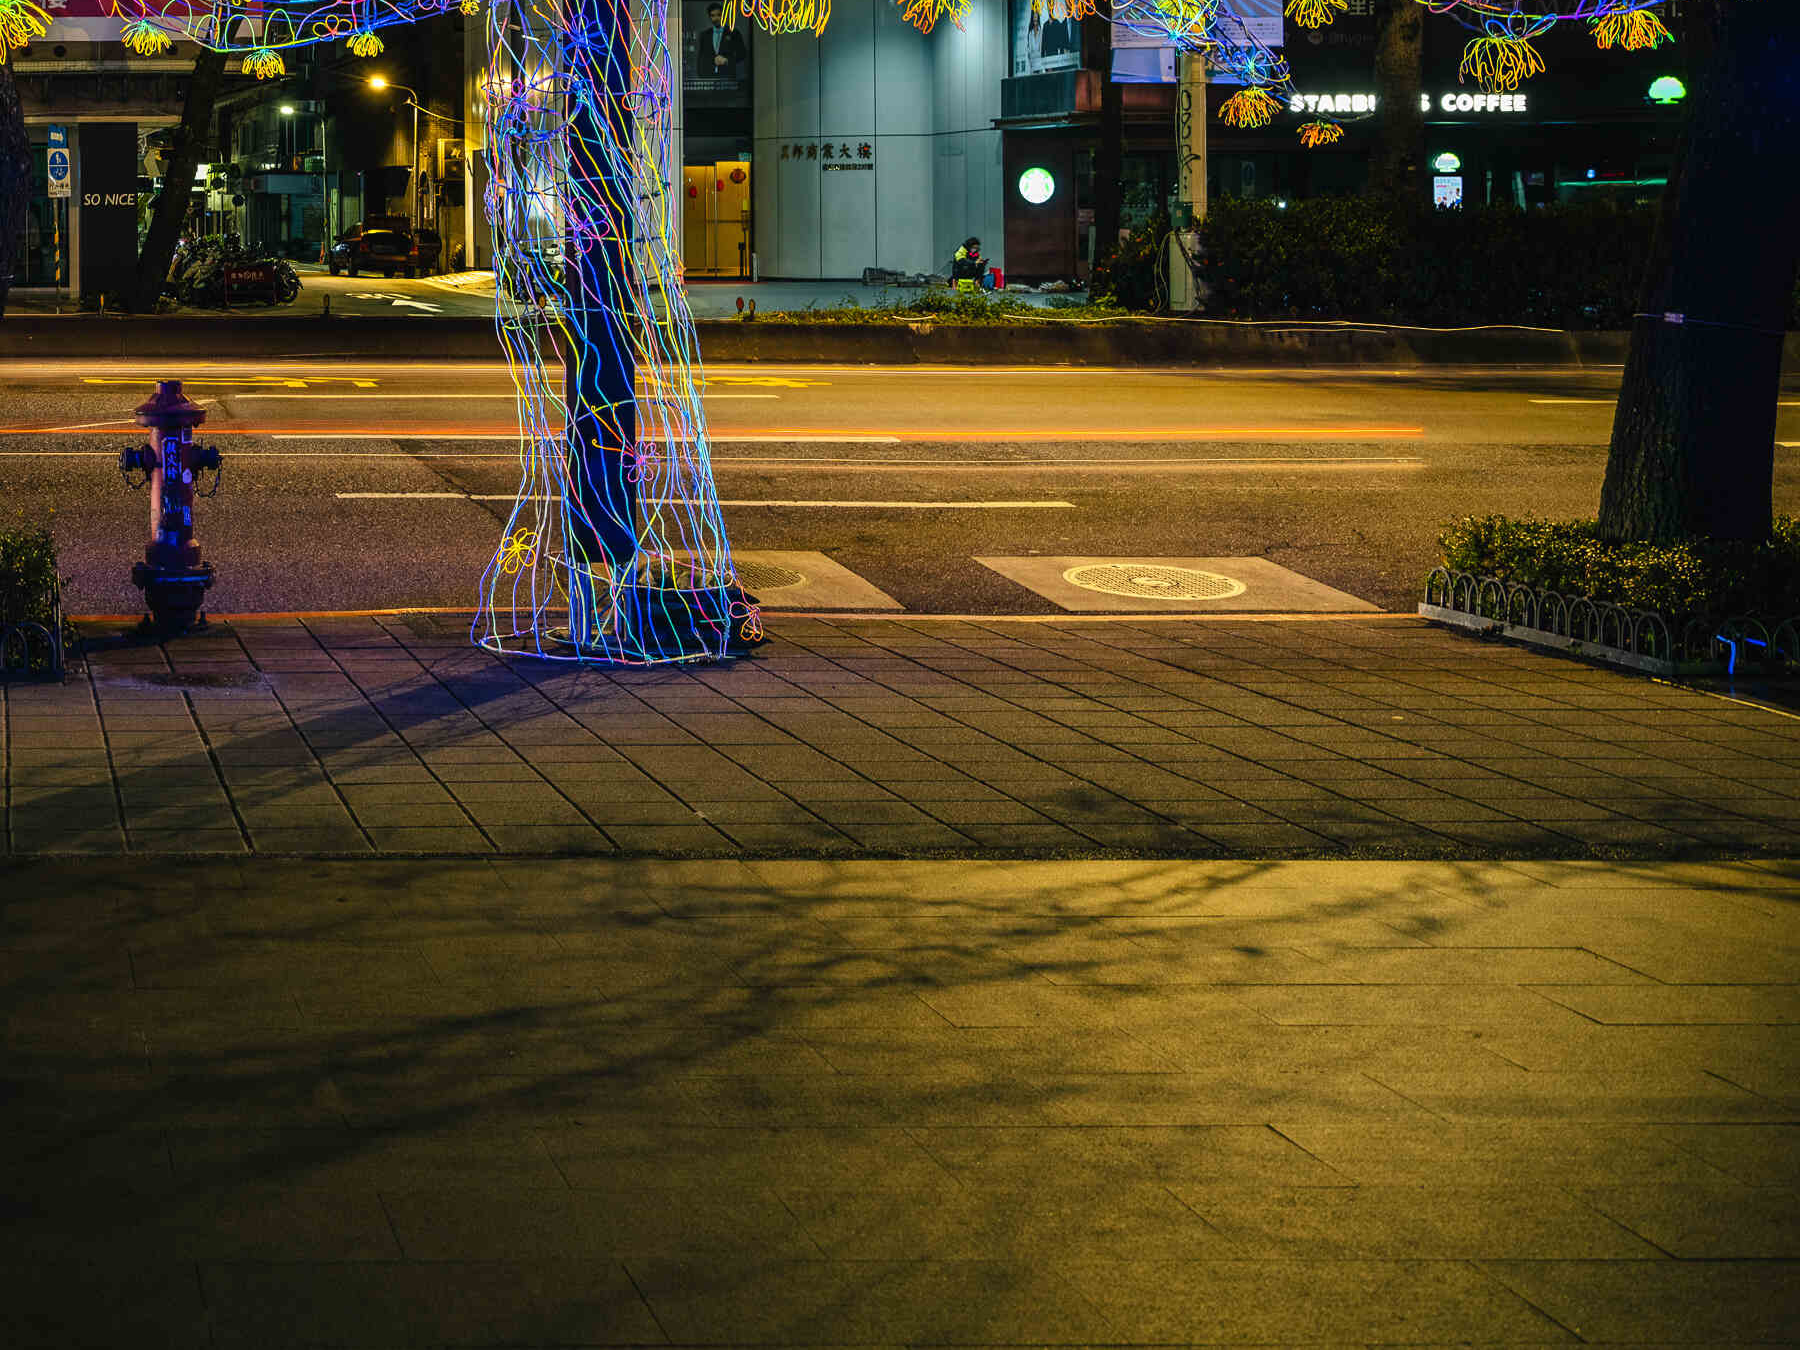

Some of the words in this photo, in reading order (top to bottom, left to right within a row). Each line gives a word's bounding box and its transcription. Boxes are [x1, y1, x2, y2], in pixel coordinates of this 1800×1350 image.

[1441, 93, 1527, 112] COFFEE
[82, 194, 101, 207] SO
[104, 194, 136, 207] NICE
